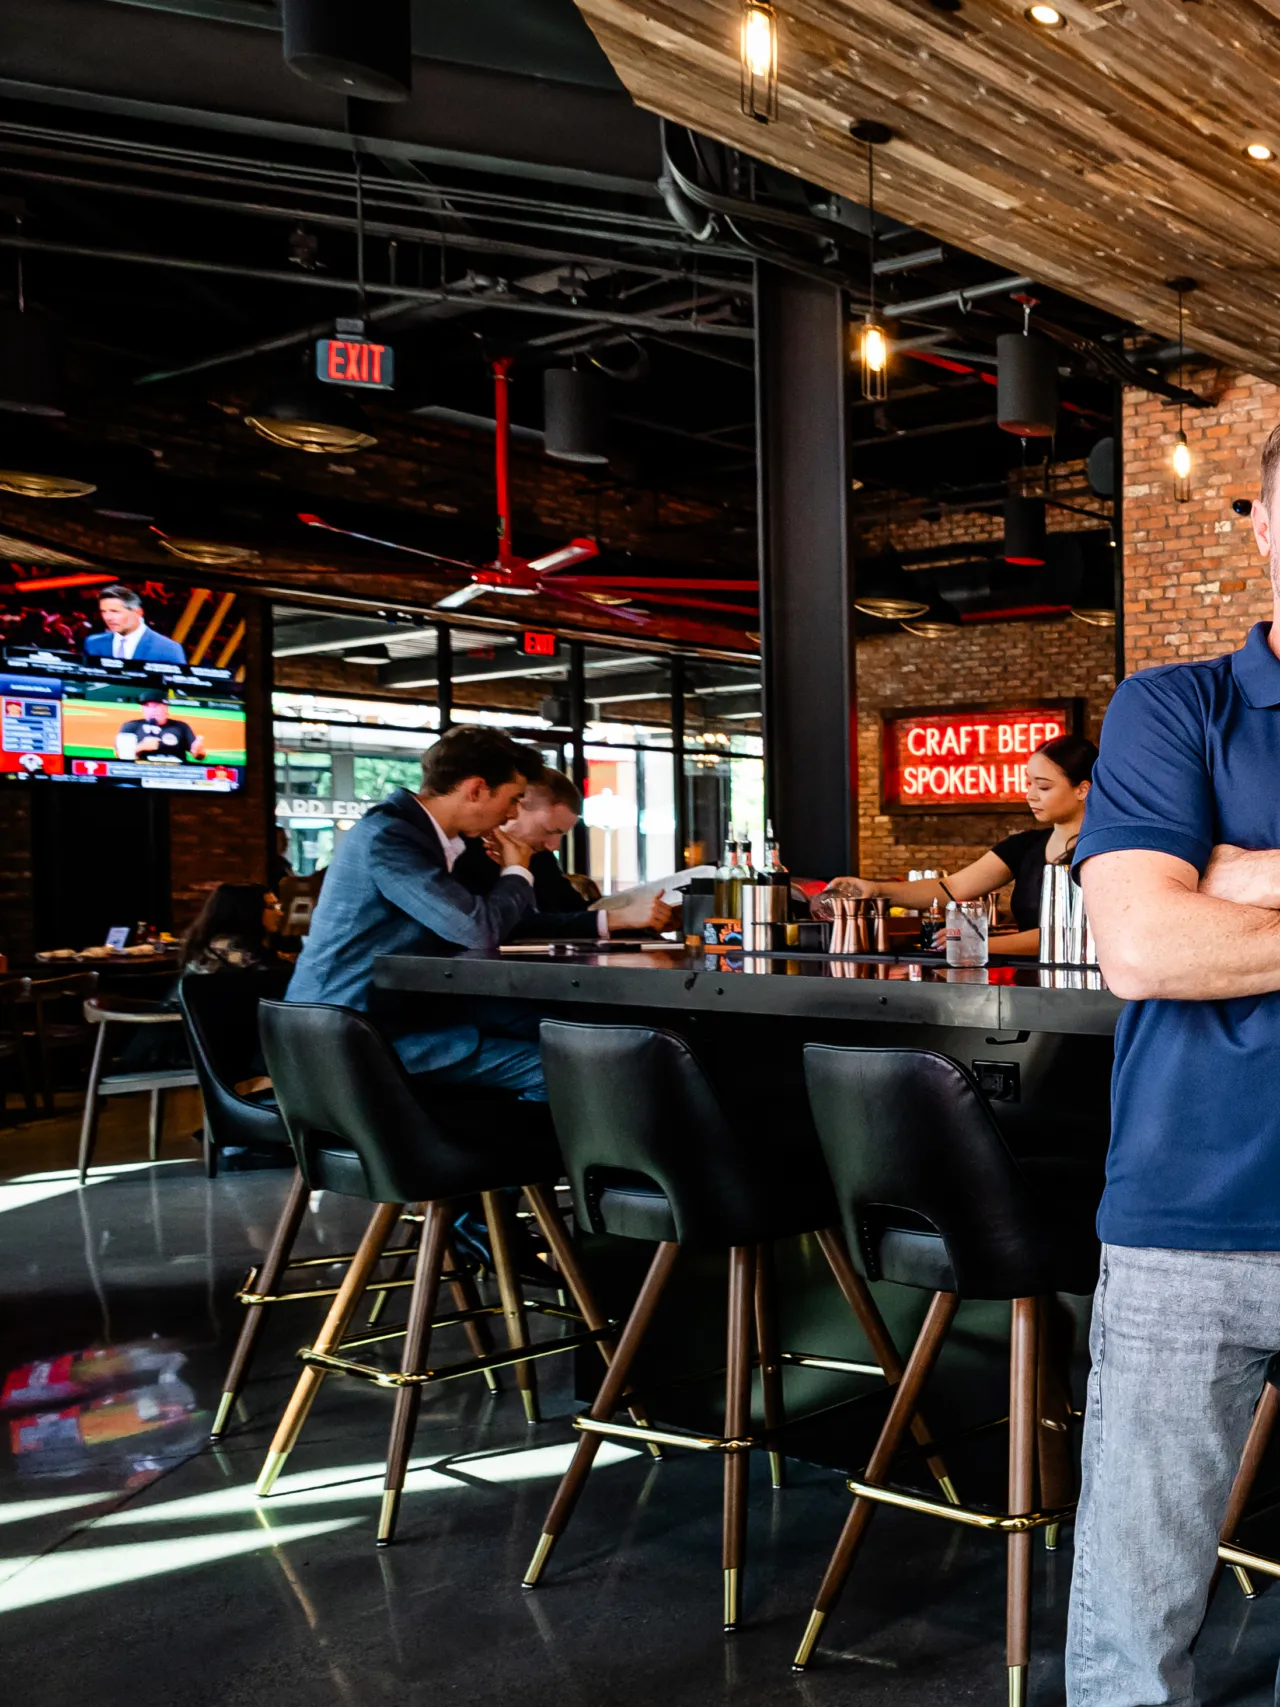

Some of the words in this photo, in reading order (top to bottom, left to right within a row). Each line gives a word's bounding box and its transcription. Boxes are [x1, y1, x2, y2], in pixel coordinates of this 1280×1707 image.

[328, 340, 385, 383] EXIT
[524, 632, 555, 656] EXIT
[907, 724, 990, 757] CRAFT
[903, 765, 996, 795] SPOKEN
[1003, 764, 1028, 793] HE
